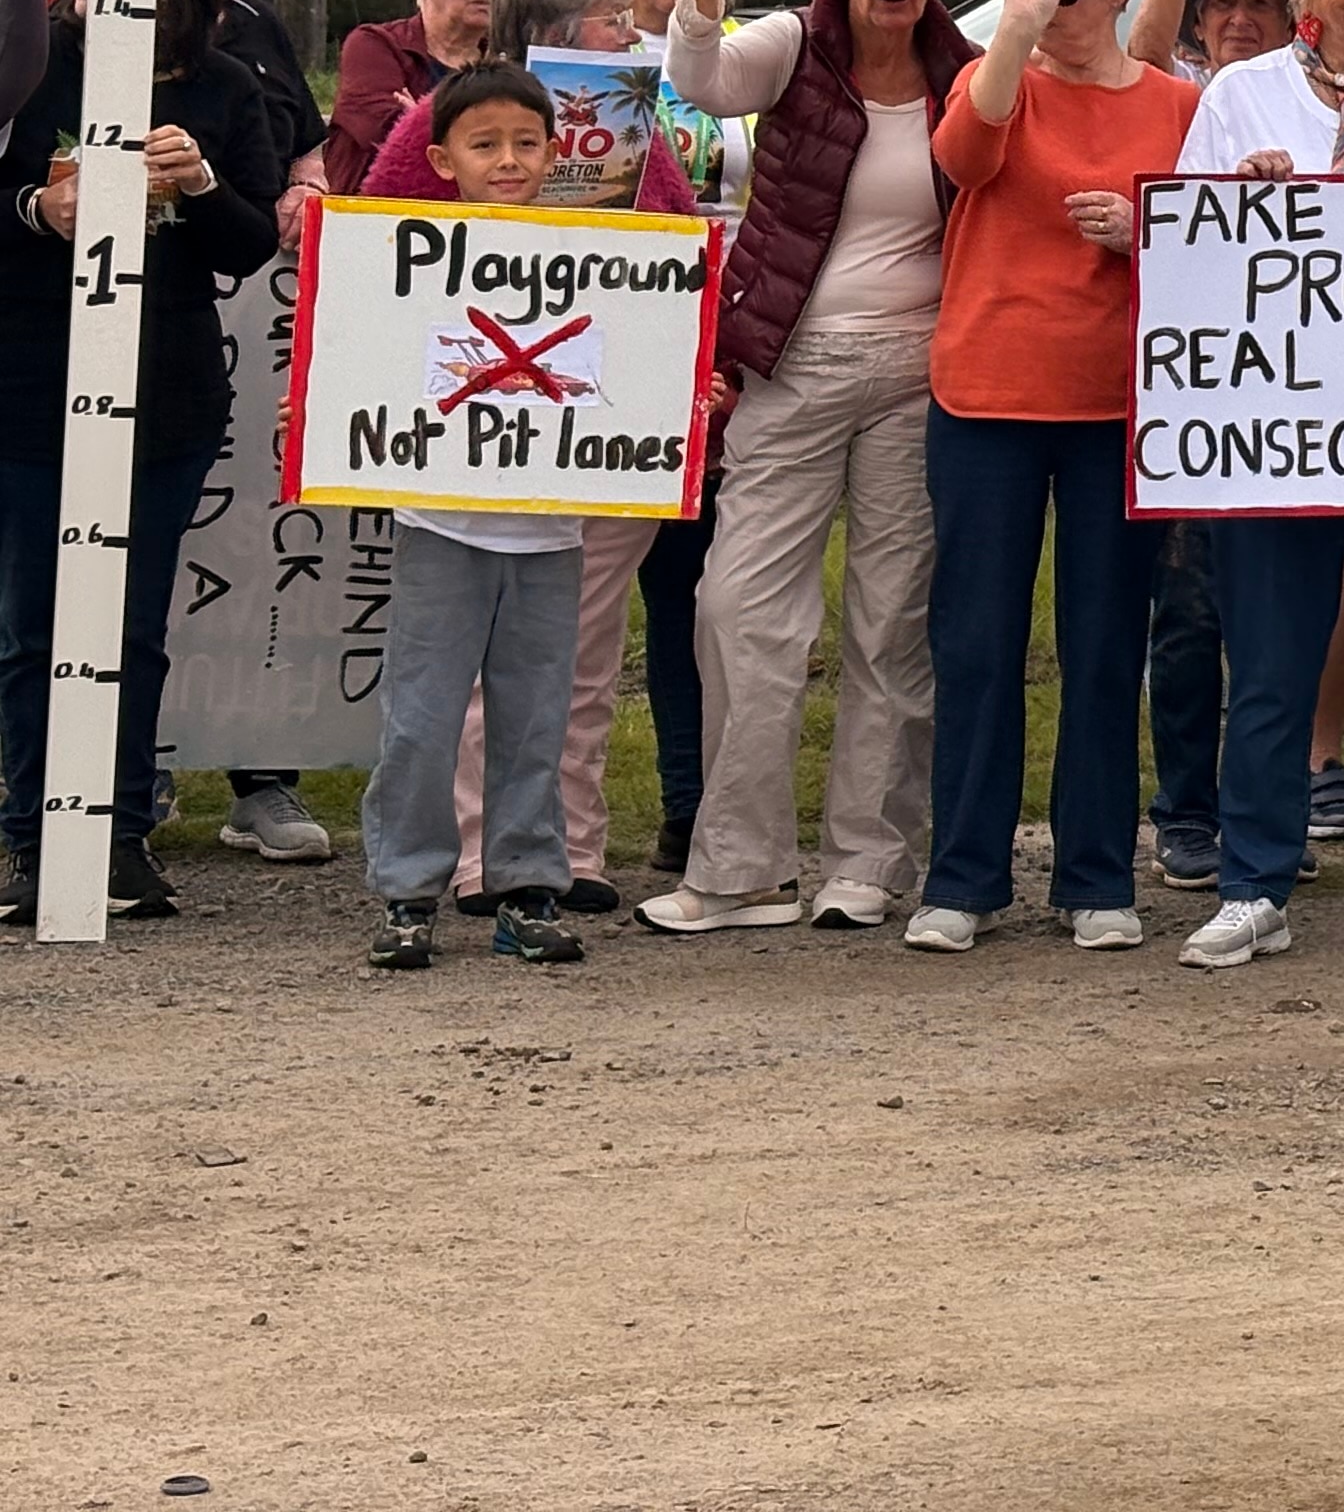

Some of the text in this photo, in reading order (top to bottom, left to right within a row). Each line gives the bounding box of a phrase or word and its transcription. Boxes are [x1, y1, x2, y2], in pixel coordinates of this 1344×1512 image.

[553, 128, 615, 159] NO
[1142, 183, 1325, 249] FAKE
[395, 219, 707, 326] Playground
[1143, 328, 1323, 390] REAL
[349, 402, 685, 471] Not Pit lanes
[339, 506, 395, 704] EHIND
